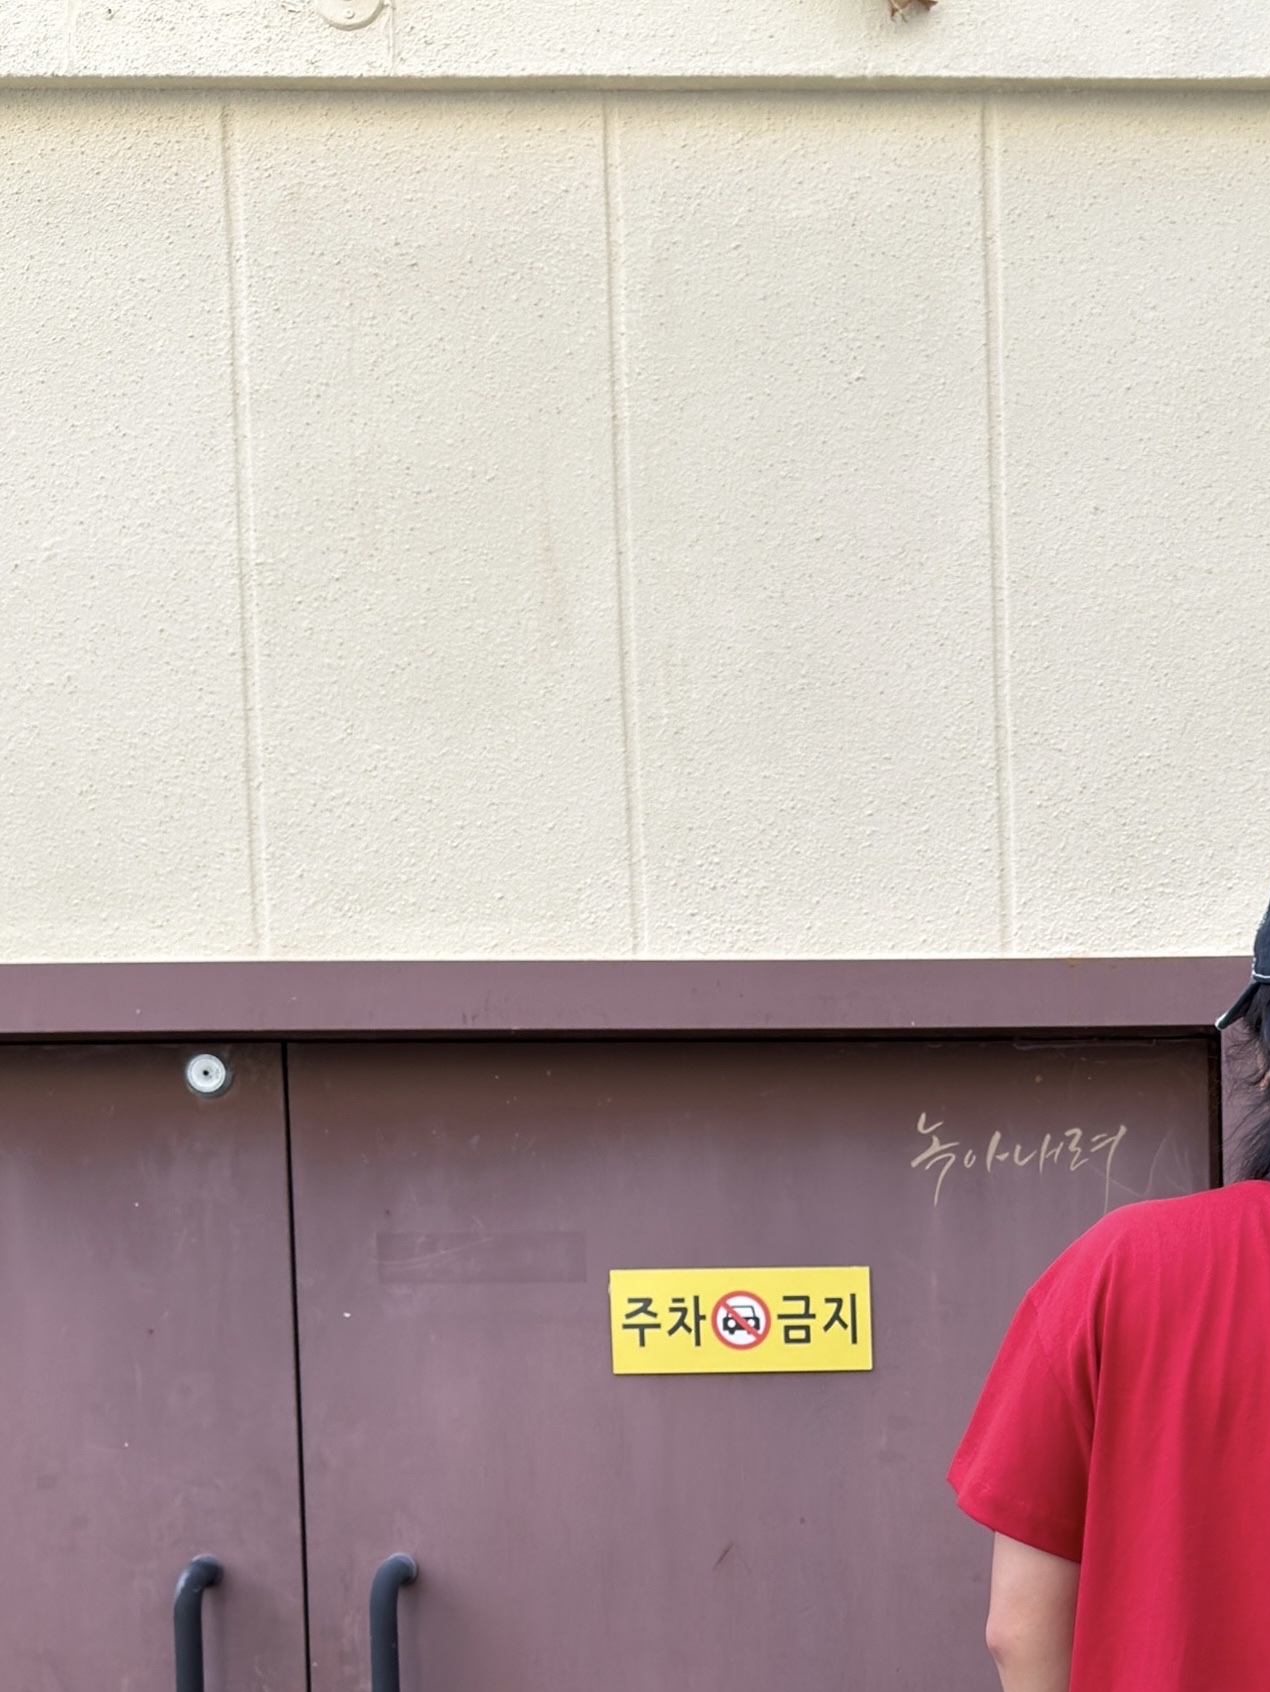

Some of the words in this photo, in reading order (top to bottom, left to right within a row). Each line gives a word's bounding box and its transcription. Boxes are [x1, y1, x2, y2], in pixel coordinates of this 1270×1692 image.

[911, 1112, 1127, 1214] 녹아내려
[622, 1295, 706, 1347] 주차
[777, 1293, 857, 1345] 금지
